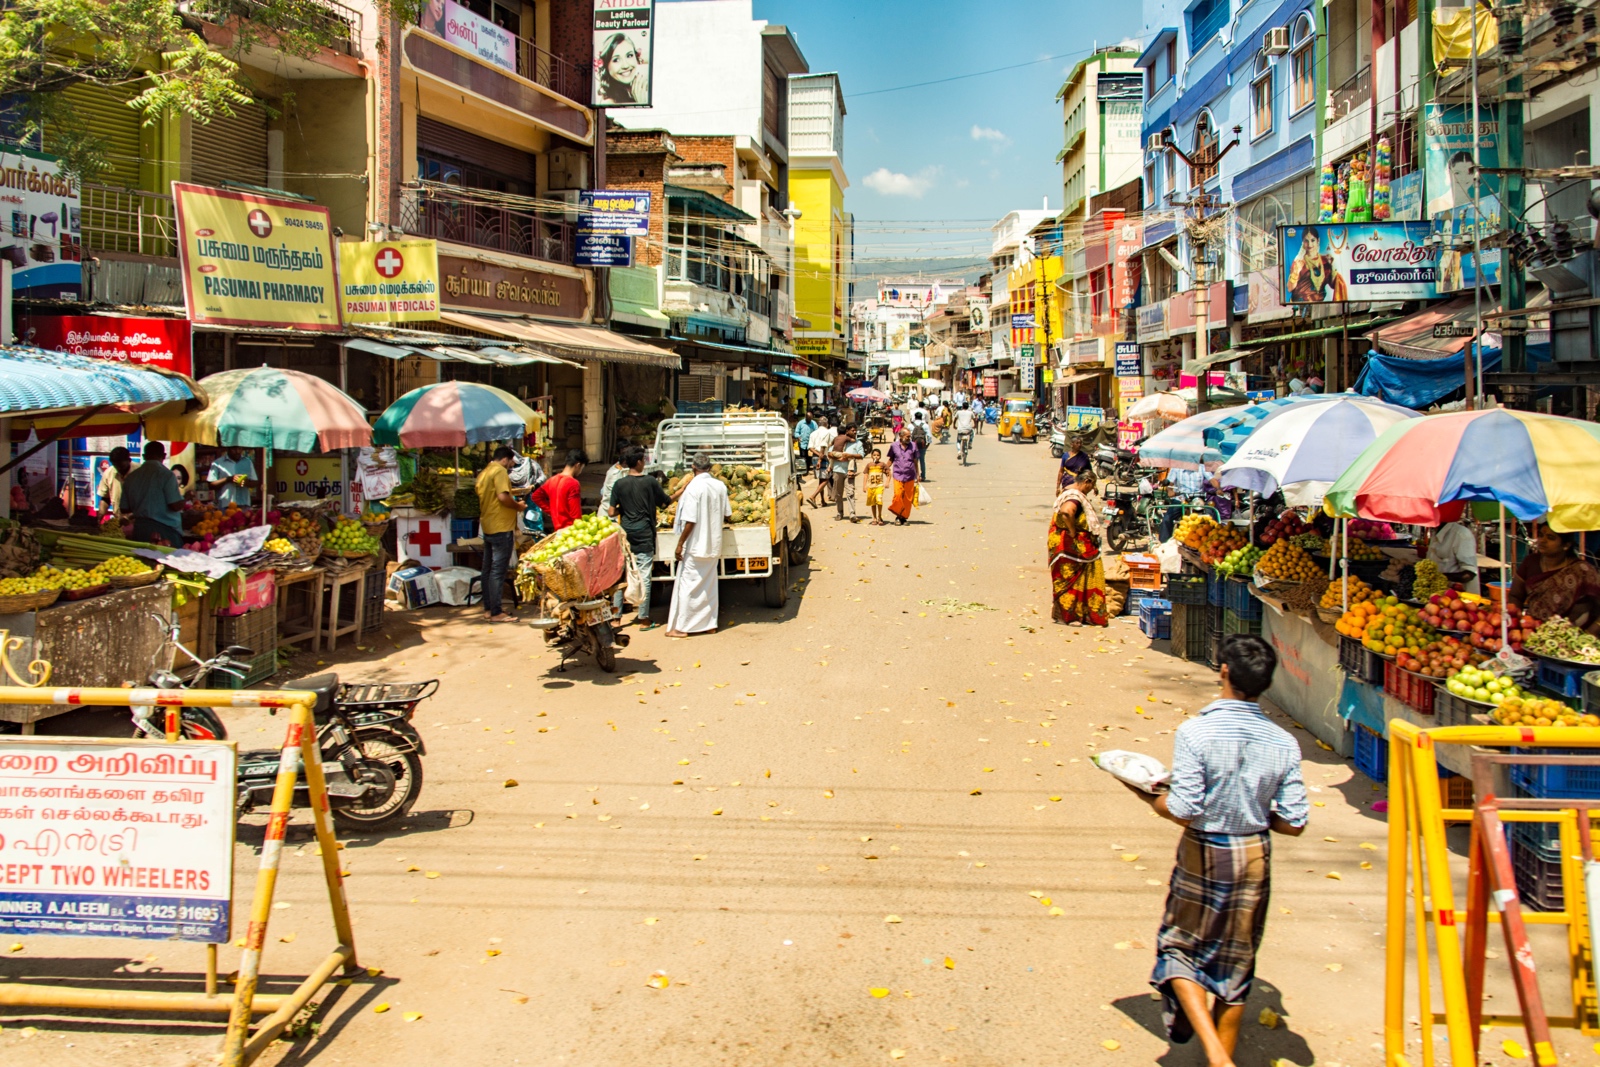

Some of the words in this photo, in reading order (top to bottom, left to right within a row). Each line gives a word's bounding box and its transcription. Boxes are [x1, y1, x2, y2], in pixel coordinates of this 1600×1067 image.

[610, 11, 635, 20] Ladies
[595, 20, 621, 29] Beauty
[622, 18, 649, 27] Parlour
[447, 18, 478, 49] அன்பு
[284, 217, 304, 227] 90424
[305, 220, 324, 230] 58459
[585, 236, 620, 247] அன்பு
[197, 238, 250, 261] பசுமை
[253, 243, 323, 272] மருந்தகம்
[1351, 240, 1436, 265] லோகிதா
[446, 265, 491, 297] சூர்யா
[204, 275, 261, 299] PASUMAI
[264, 282, 324, 304] PHARMACY
[345, 284, 377, 296] பசுமை
[347, 301, 387, 313] PASUMAI
[389, 299, 436, 312] MEDICALS
[122, 332, 162, 346] அதிவேக
[130, 349, 174, 362] மாறுங்கள்
[1027, 357, 1035, 389] INDHRA
[67, 753, 217, 781] அறிவிப்பு
[152, 788, 205, 804] தவிர
[50, 865, 95, 886] TWO
[103, 866, 210, 891] WHEELERS
[135, 904, 177, 919] 98425
